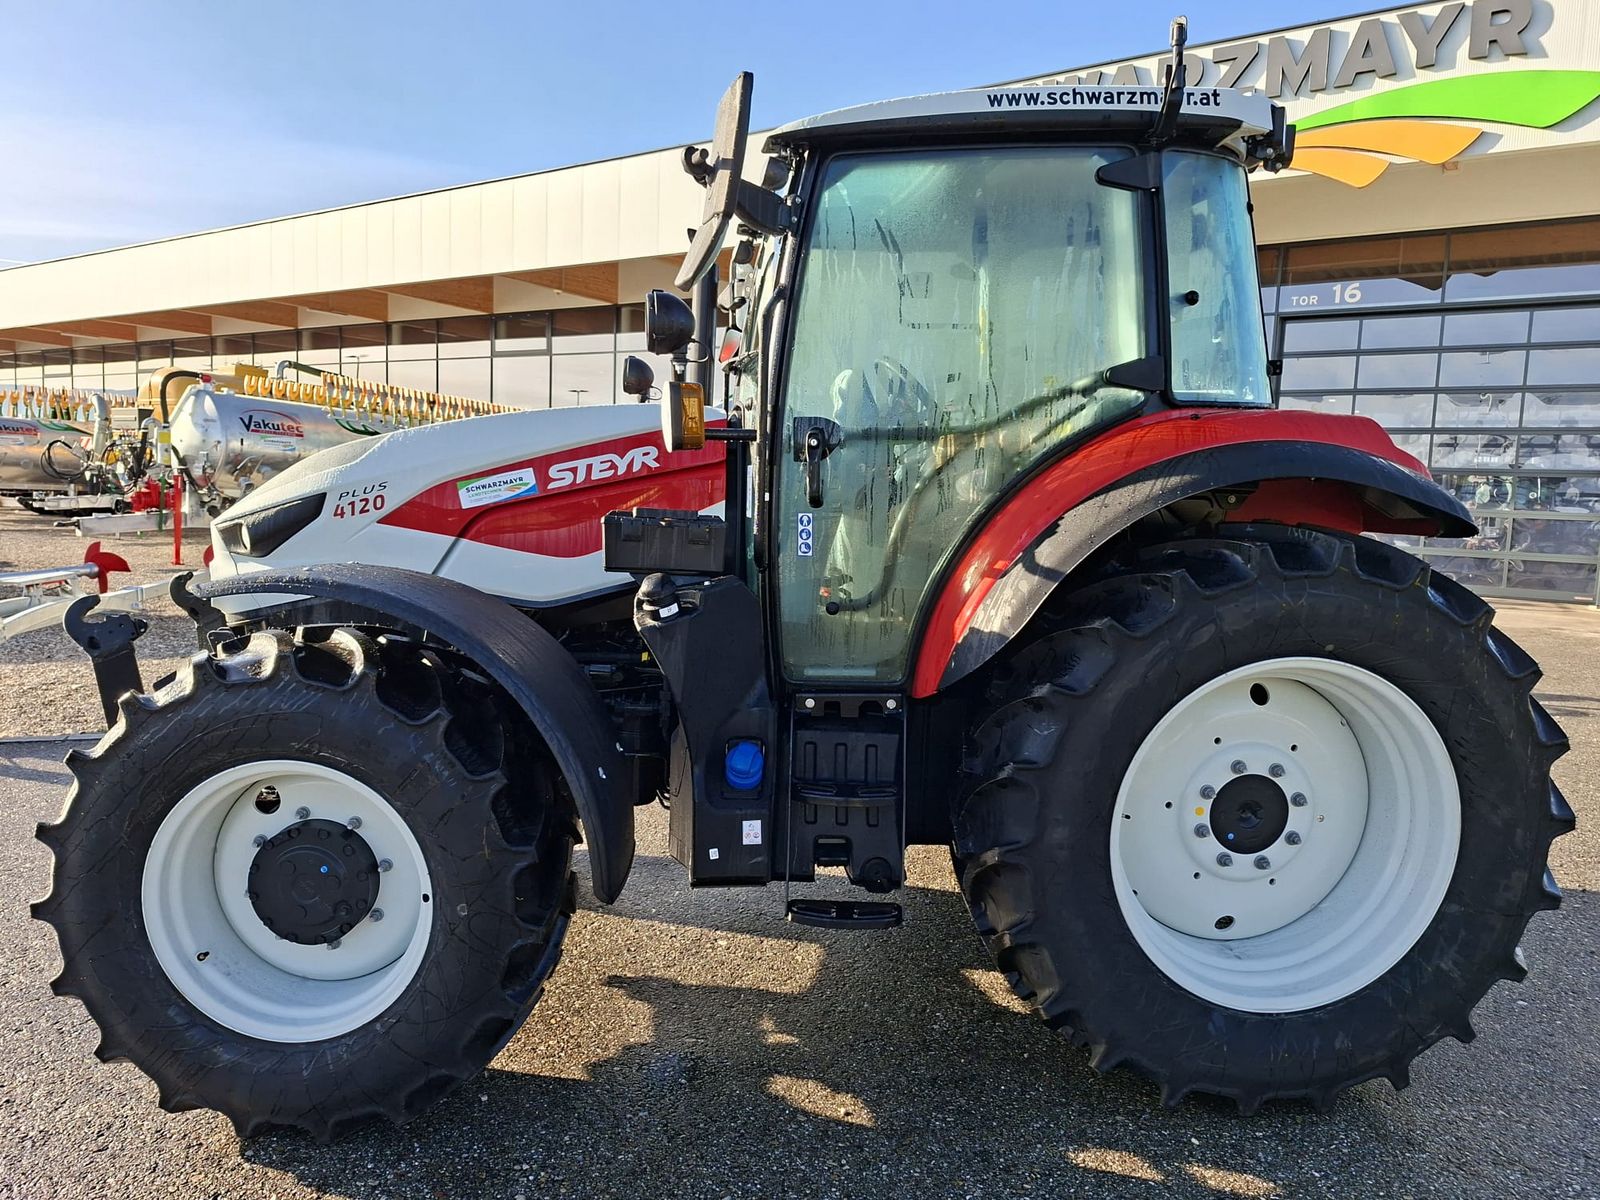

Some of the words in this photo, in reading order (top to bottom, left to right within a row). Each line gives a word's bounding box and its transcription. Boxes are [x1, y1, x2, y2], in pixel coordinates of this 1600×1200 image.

[987, 87, 1220, 107] www.schwarzmr.at
[1291, 295, 1318, 306] TOR
[1332, 282, 1361, 304] 16
[239, 414, 304, 433] Vakutec
[546, 445, 661, 490] STEYR
[338, 481, 388, 501] PLUS
[465, 476, 524, 493] SCHWARZMAYR
[333, 494, 385, 519] 4120
